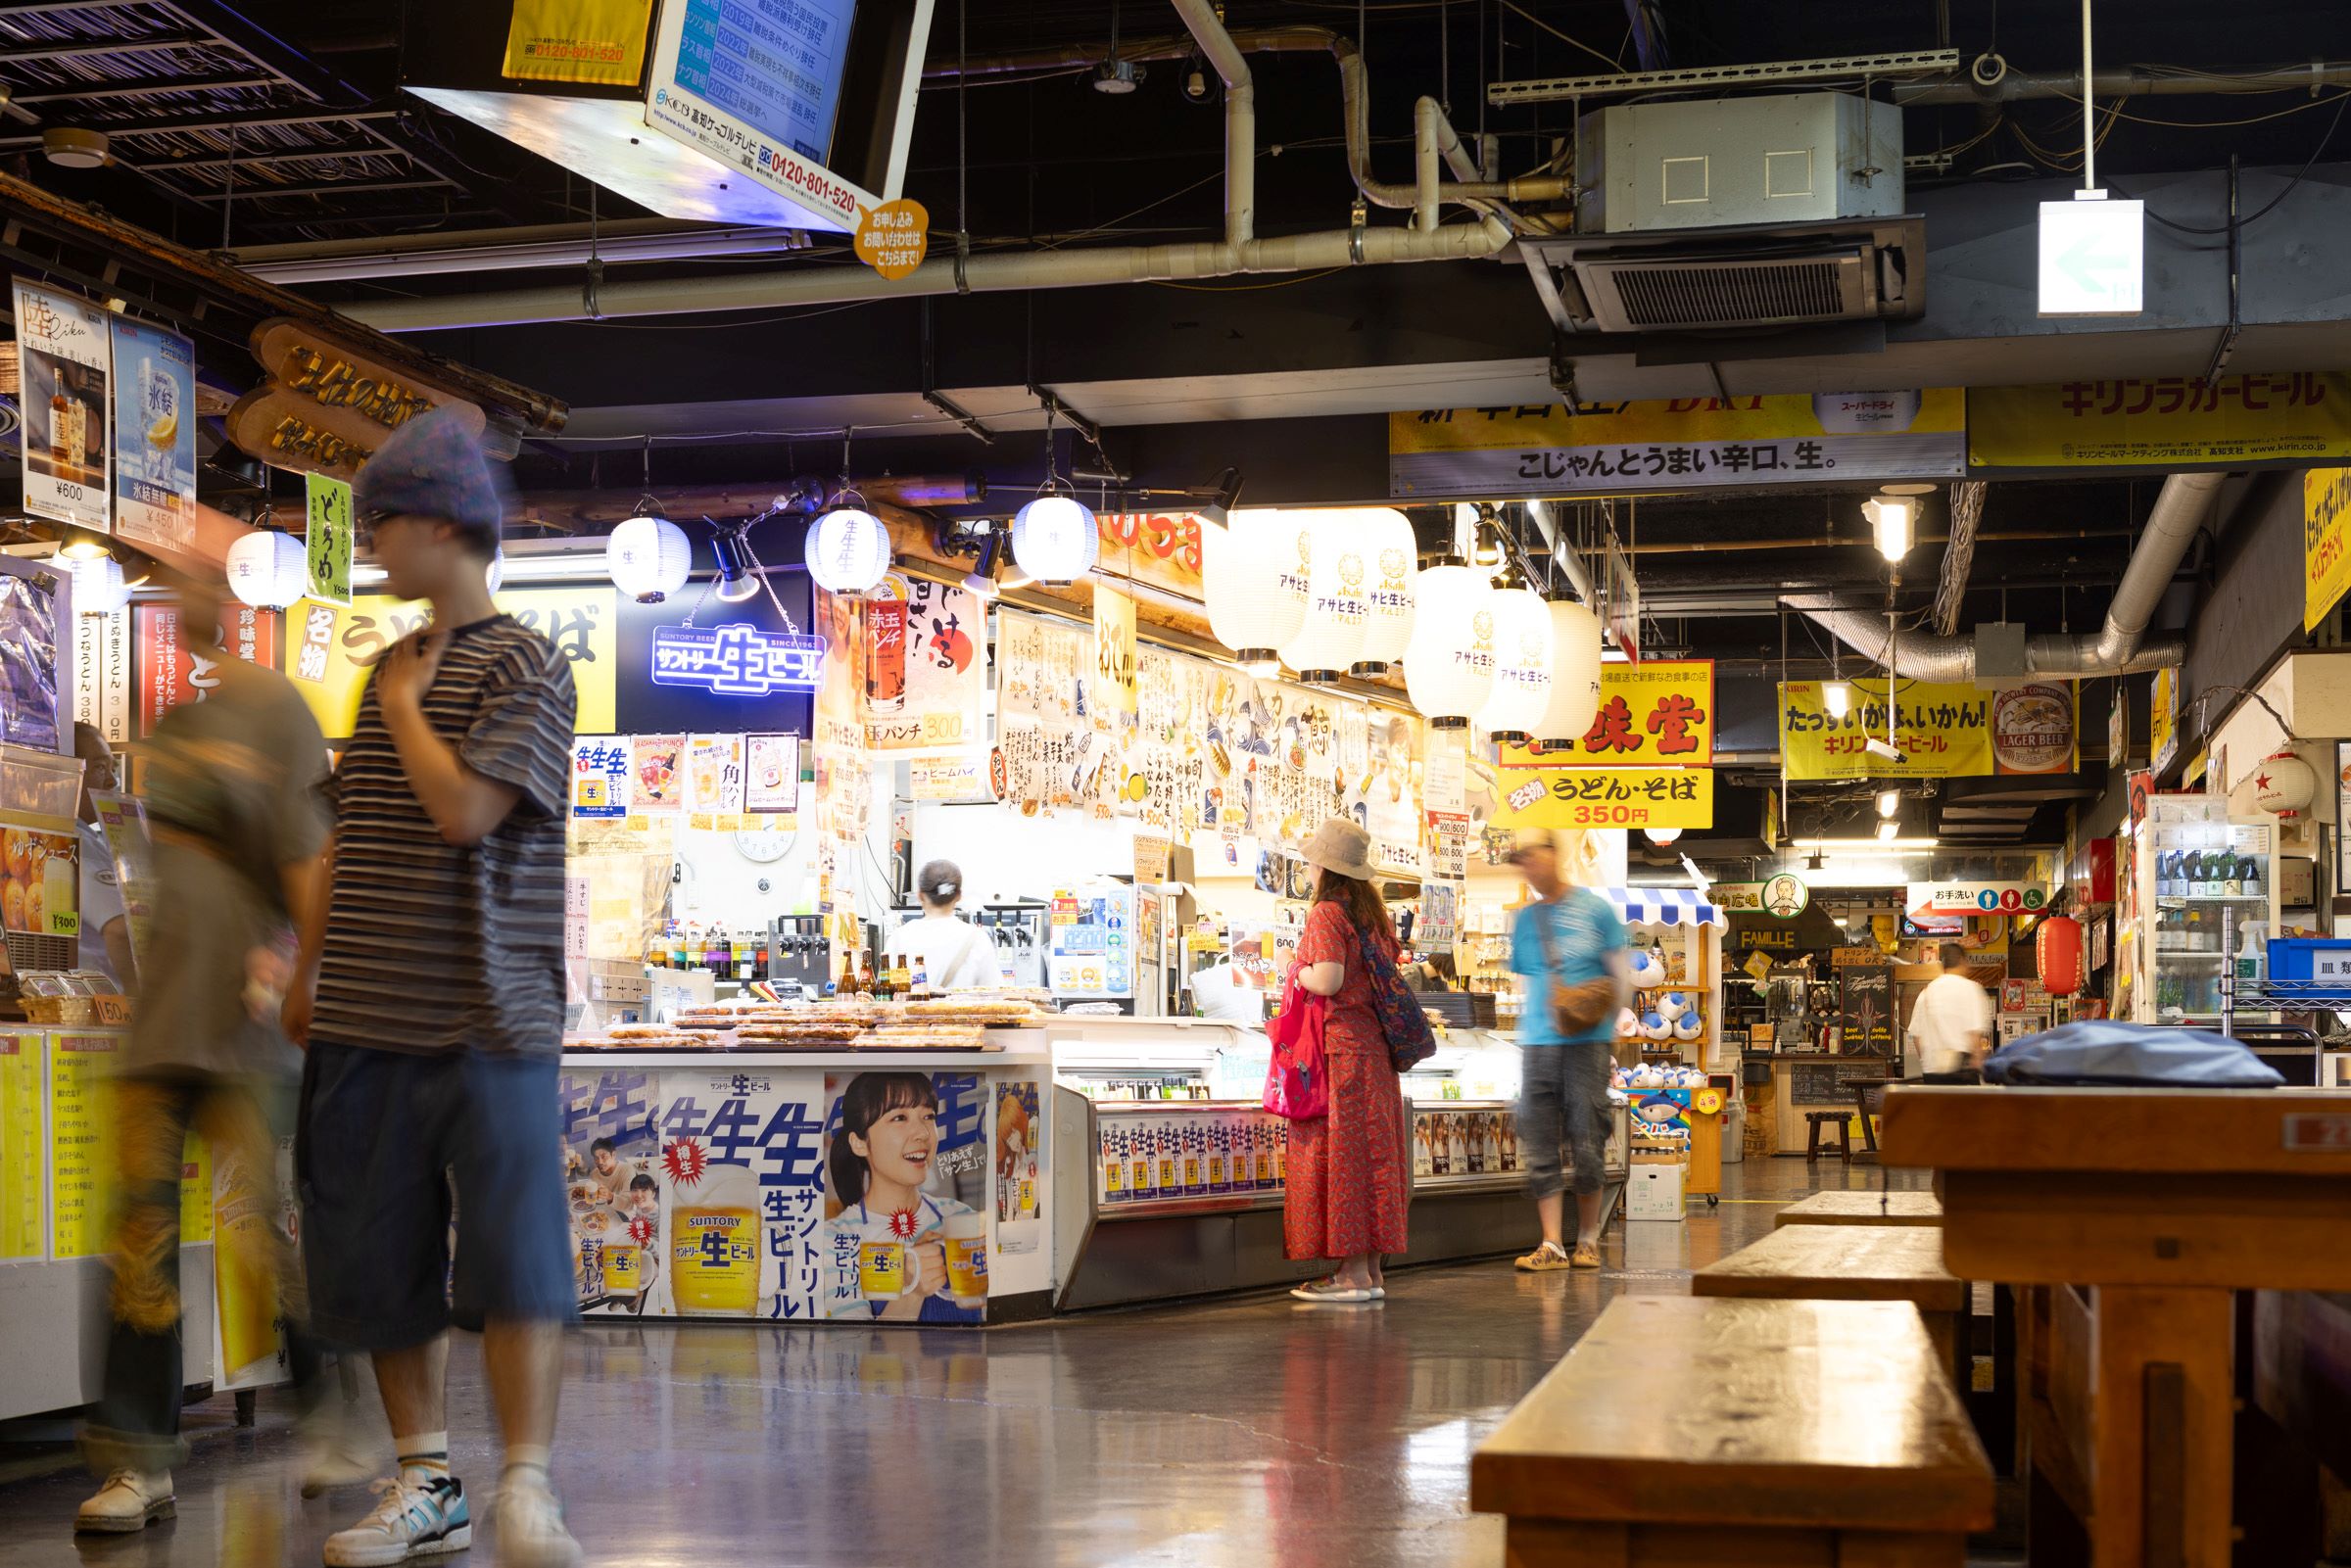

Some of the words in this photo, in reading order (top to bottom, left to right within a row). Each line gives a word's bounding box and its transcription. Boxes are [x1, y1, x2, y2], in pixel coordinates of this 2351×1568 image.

[718, 27, 748, 58] 2022年
[723, 2, 753, 32] 2019年
[753, 22, 816, 70] 離脱条件めぐり辞任
[536, 44, 624, 62] 0120-801-520
[714, 54, 744, 83] 2022年
[665, 95, 690, 117] KCB
[691, 109, 757, 155] 高知ケーブルテレビ
[772, 153, 855, 213] 0120-801-520
[873, 212, 914, 228] お申し込み
[864, 231, 921, 248] お問い合わせは
[22, 292, 51, 339] 陸
[48, 313, 86, 342] Riku
[149, 384, 173, 412] 氷結
[1842, 401, 1895, 411] スーパードライ
[2062, 371, 2326, 417] キリンラガービール
[1519, 442, 1835, 478] こじゃんとうまい辛口、生。
[2077, 447, 2202, 458] キリンビールマーケティング株式会社
[2209, 447, 2245, 455] 高知支社
[2250, 443, 2327, 454] www.kirin.co.jp
[56, 481, 82, 501] ¥600
[133, 482, 168, 507] 氷結無糖
[146, 508, 173, 530] ¥450
[318, 488, 339, 580] どろめ
[837, 519, 859, 574] 生生生
[239, 563, 252, 576] 生
[333, 584, 349, 594] ¥500
[1337, 586, 1363, 598] Asahi
[1379, 580, 1406, 592] Asahi
[869, 609, 899, 628] 赤玉
[302, 607, 332, 680] 名物
[868, 626, 900, 649] パンチ
[167, 613, 176, 705] 日本そばもうどんと
[2004, 735, 2036, 746] LAGER
[2039, 734, 2063, 745] BEER
[1507, 778, 1548, 812] 名物
[1553, 776, 1699, 800] うどん・そば
[1574, 805, 1649, 824] 350円
[1452, 823, 1465, 833] 600
[12, 837, 79, 864] ゆずジュース
[1451, 847, 1463, 858] 600
[1450, 862, 1463, 872] 600
[1936, 890, 1974, 899] お手洗い
[1742, 931, 1794, 948] FAMILLE
[710, 1074, 771, 1096] サントリー生ビール
[676, 1145, 693, 1175] 樽生
[936, 1145, 975, 1166] とりあえず
[690, 1217, 741, 1226] SUNTORY
[676, 1231, 754, 1267] サントリー生ビール
[764, 1190, 799, 1318] 生ビール
[795, 1189, 819, 1317] サントリー
[581, 1238, 595, 1295] 生ビール
[835, 1234, 849, 1299] 生ビール
[849, 1234, 860, 1299] サントリー
